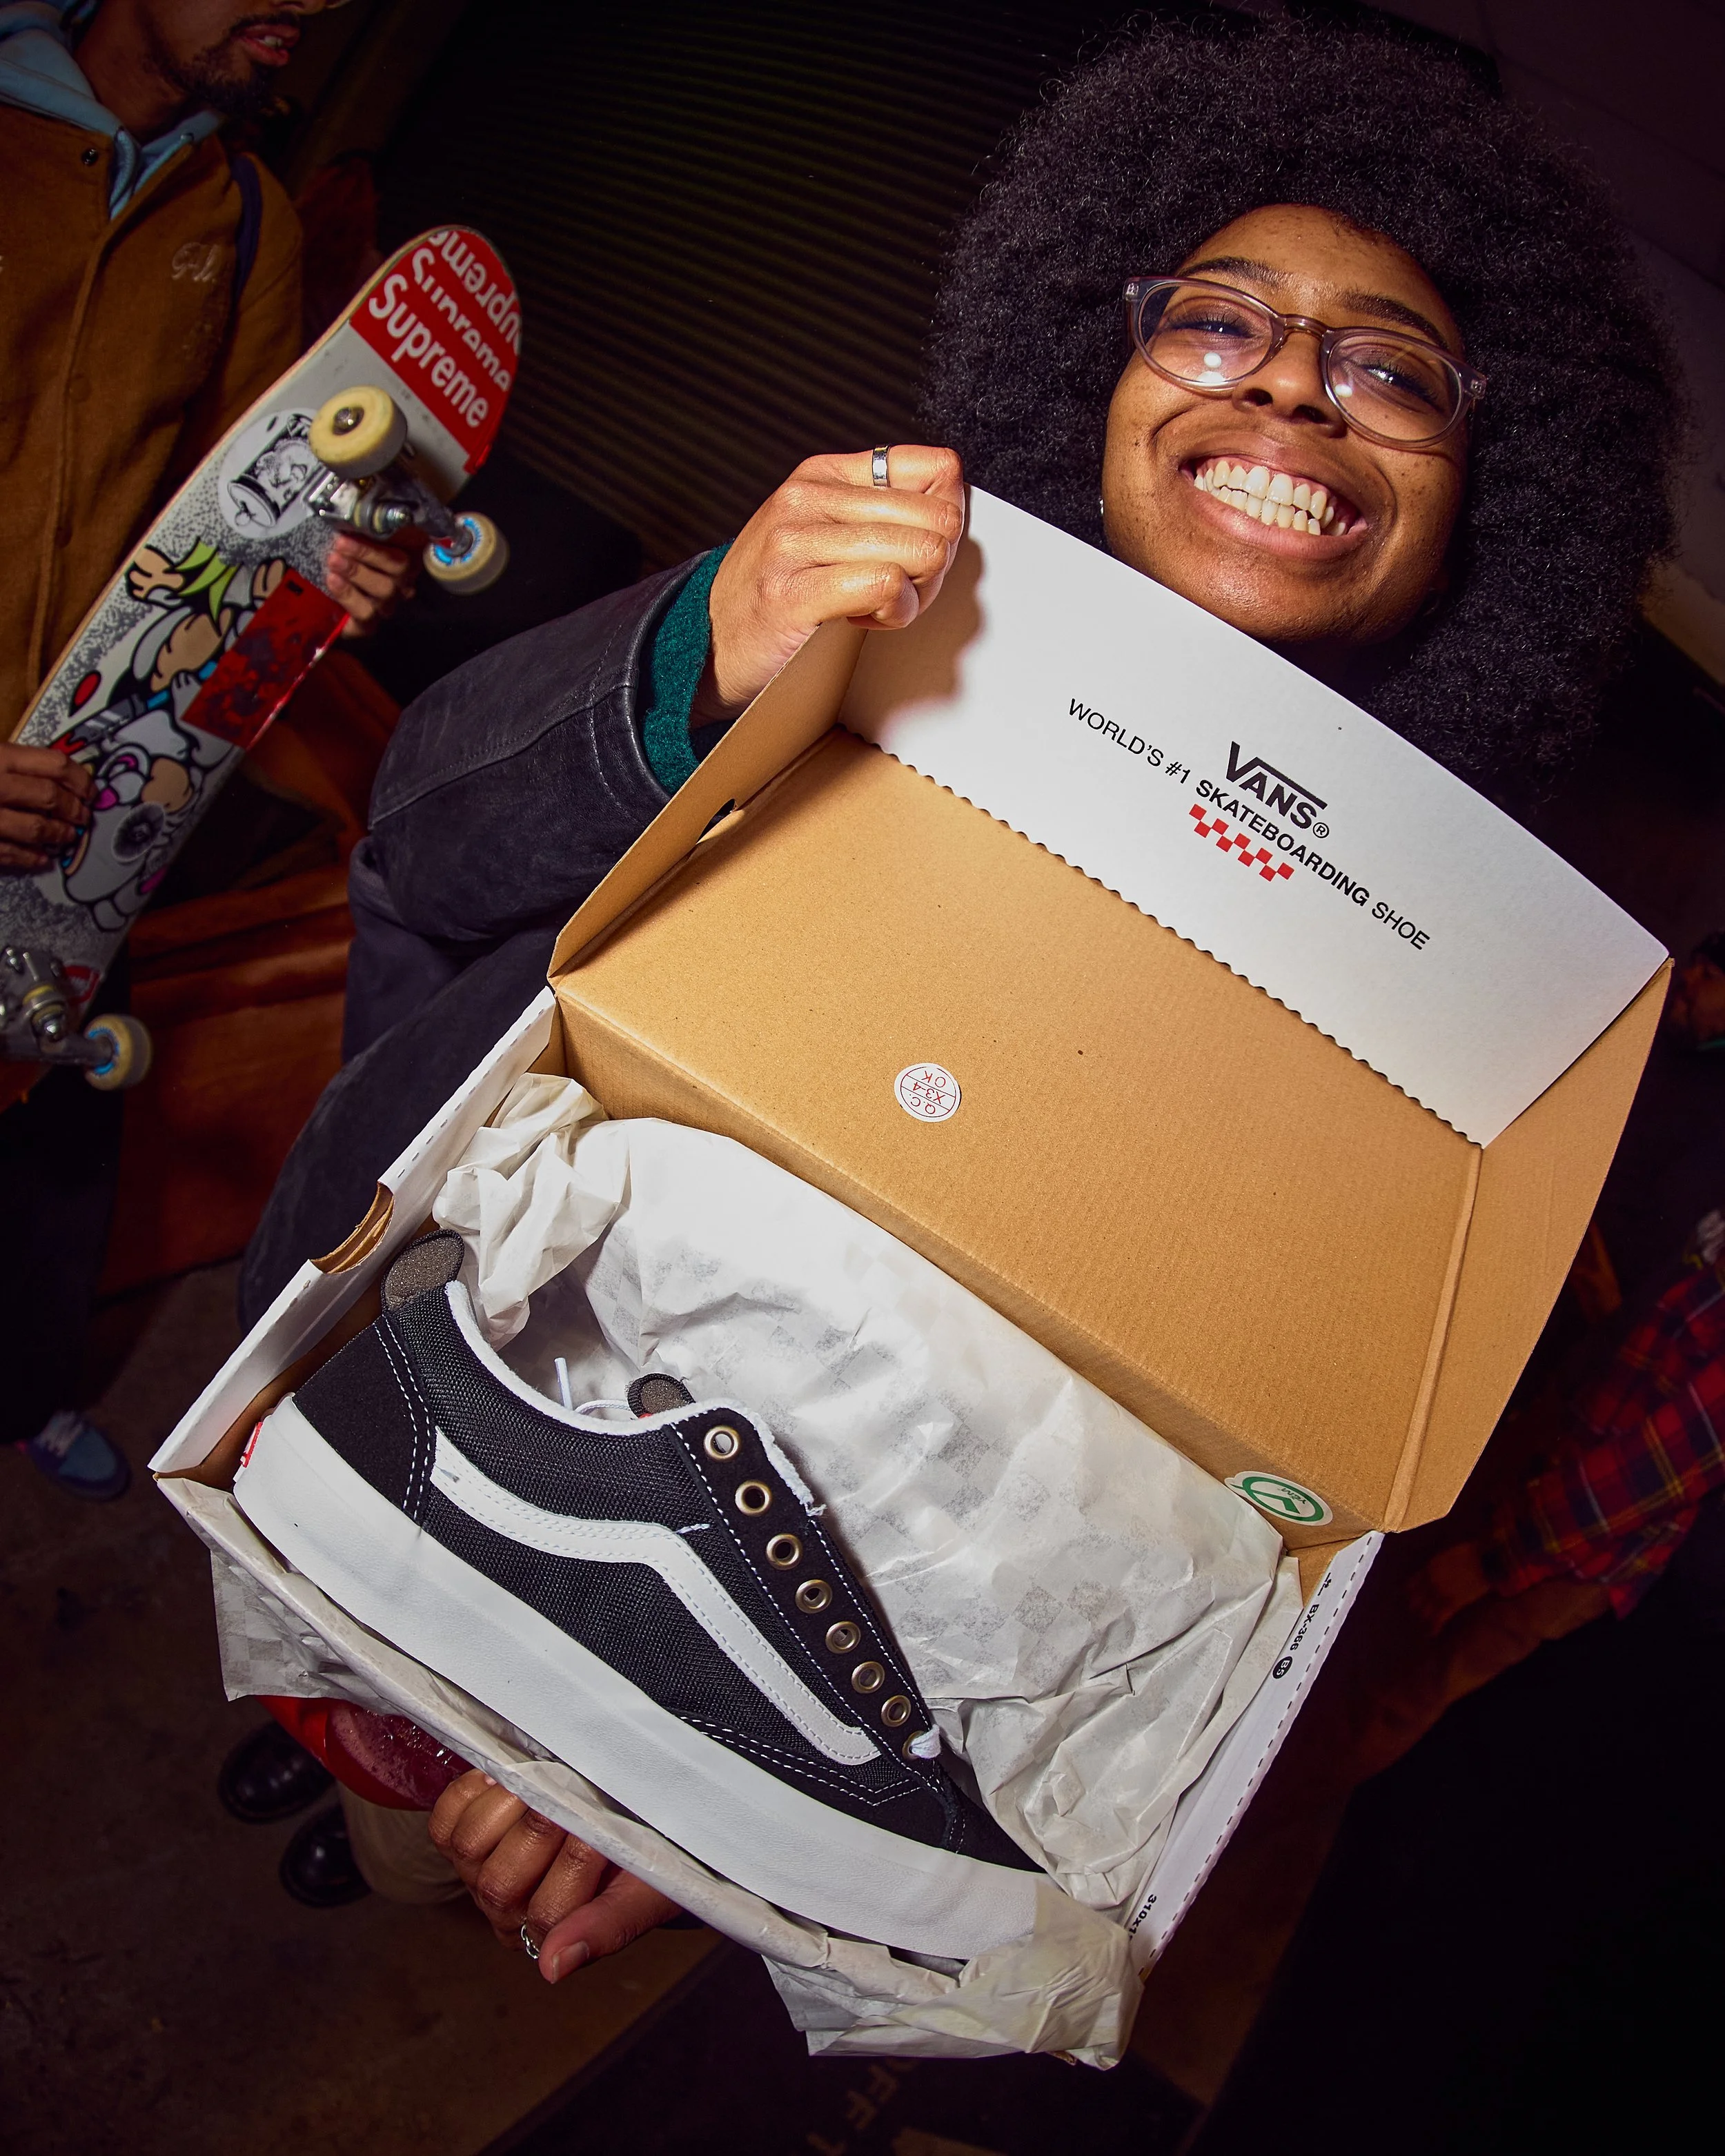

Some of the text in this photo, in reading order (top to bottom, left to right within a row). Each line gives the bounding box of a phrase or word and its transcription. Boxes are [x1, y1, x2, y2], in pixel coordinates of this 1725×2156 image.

[428, 230, 521, 356] uprem
[368, 273, 489, 428] Supreme
[1068, 698, 1430, 951] WORLD'S #1 SKATEBOARDING SHOE
[921, 1070, 947, 1088] OK
[1290, 1603, 1320, 1651] BX-366
[1128, 1894, 1157, 1941] 310x1
